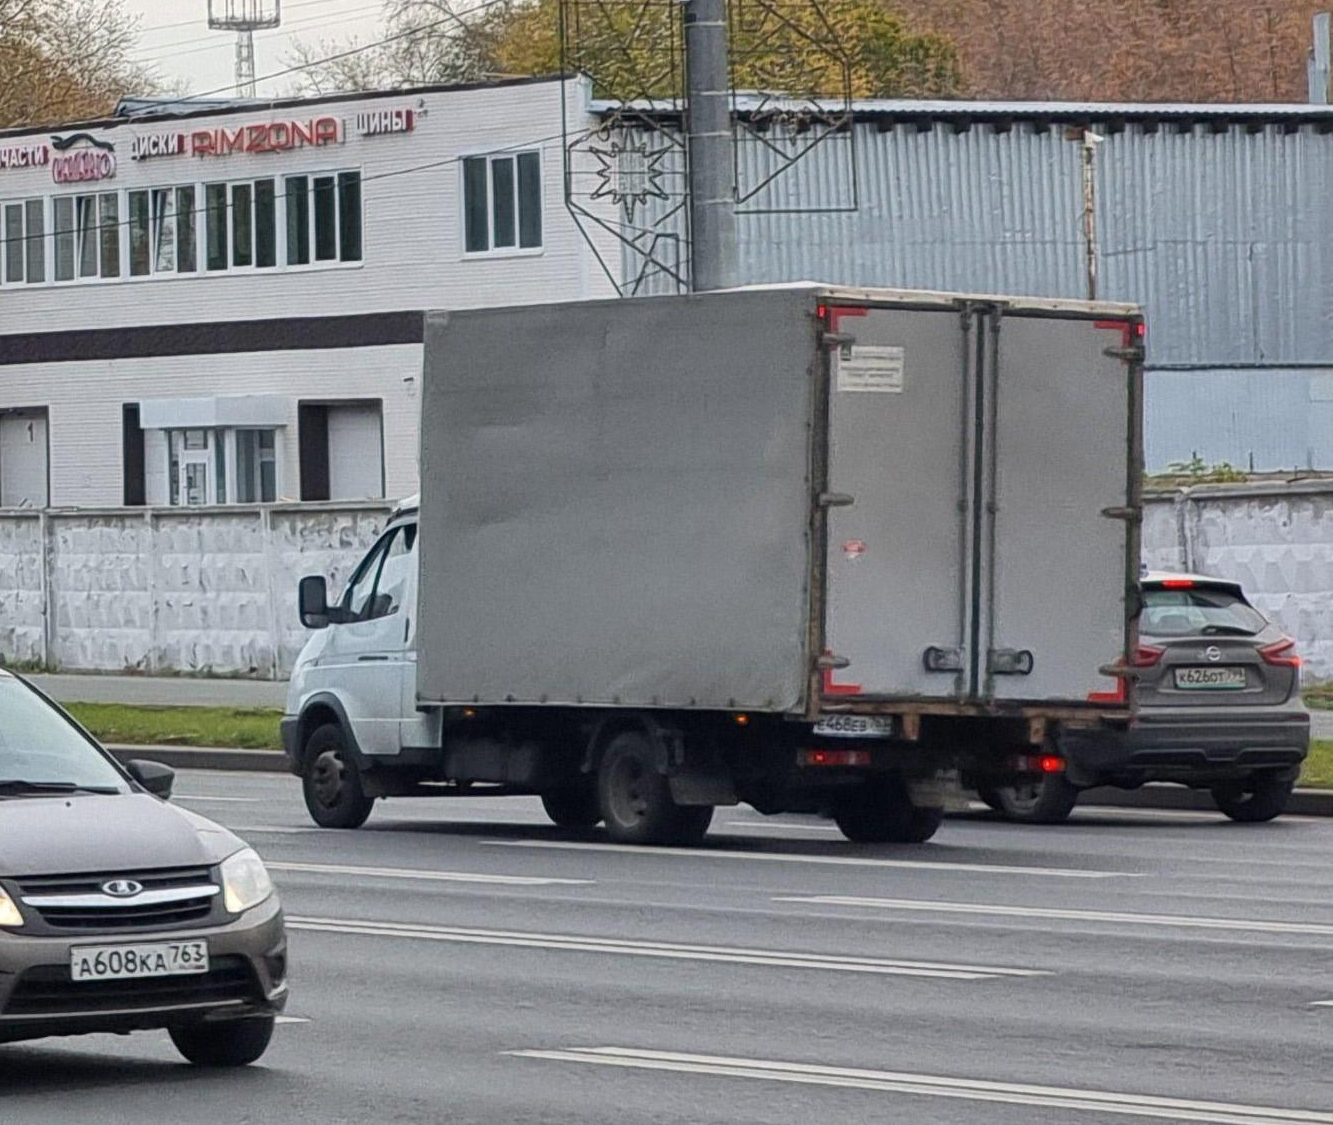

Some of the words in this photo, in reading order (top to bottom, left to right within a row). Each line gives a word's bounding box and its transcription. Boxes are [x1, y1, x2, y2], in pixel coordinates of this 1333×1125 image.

[192, 116, 342, 156] RIMZONA
[357, 110, 414, 136] ШИНЫ
[132, 134, 184, 159] ДИСКИ
[80, 950, 167, 977] А608КА
[169, 944, 206, 964] 763
